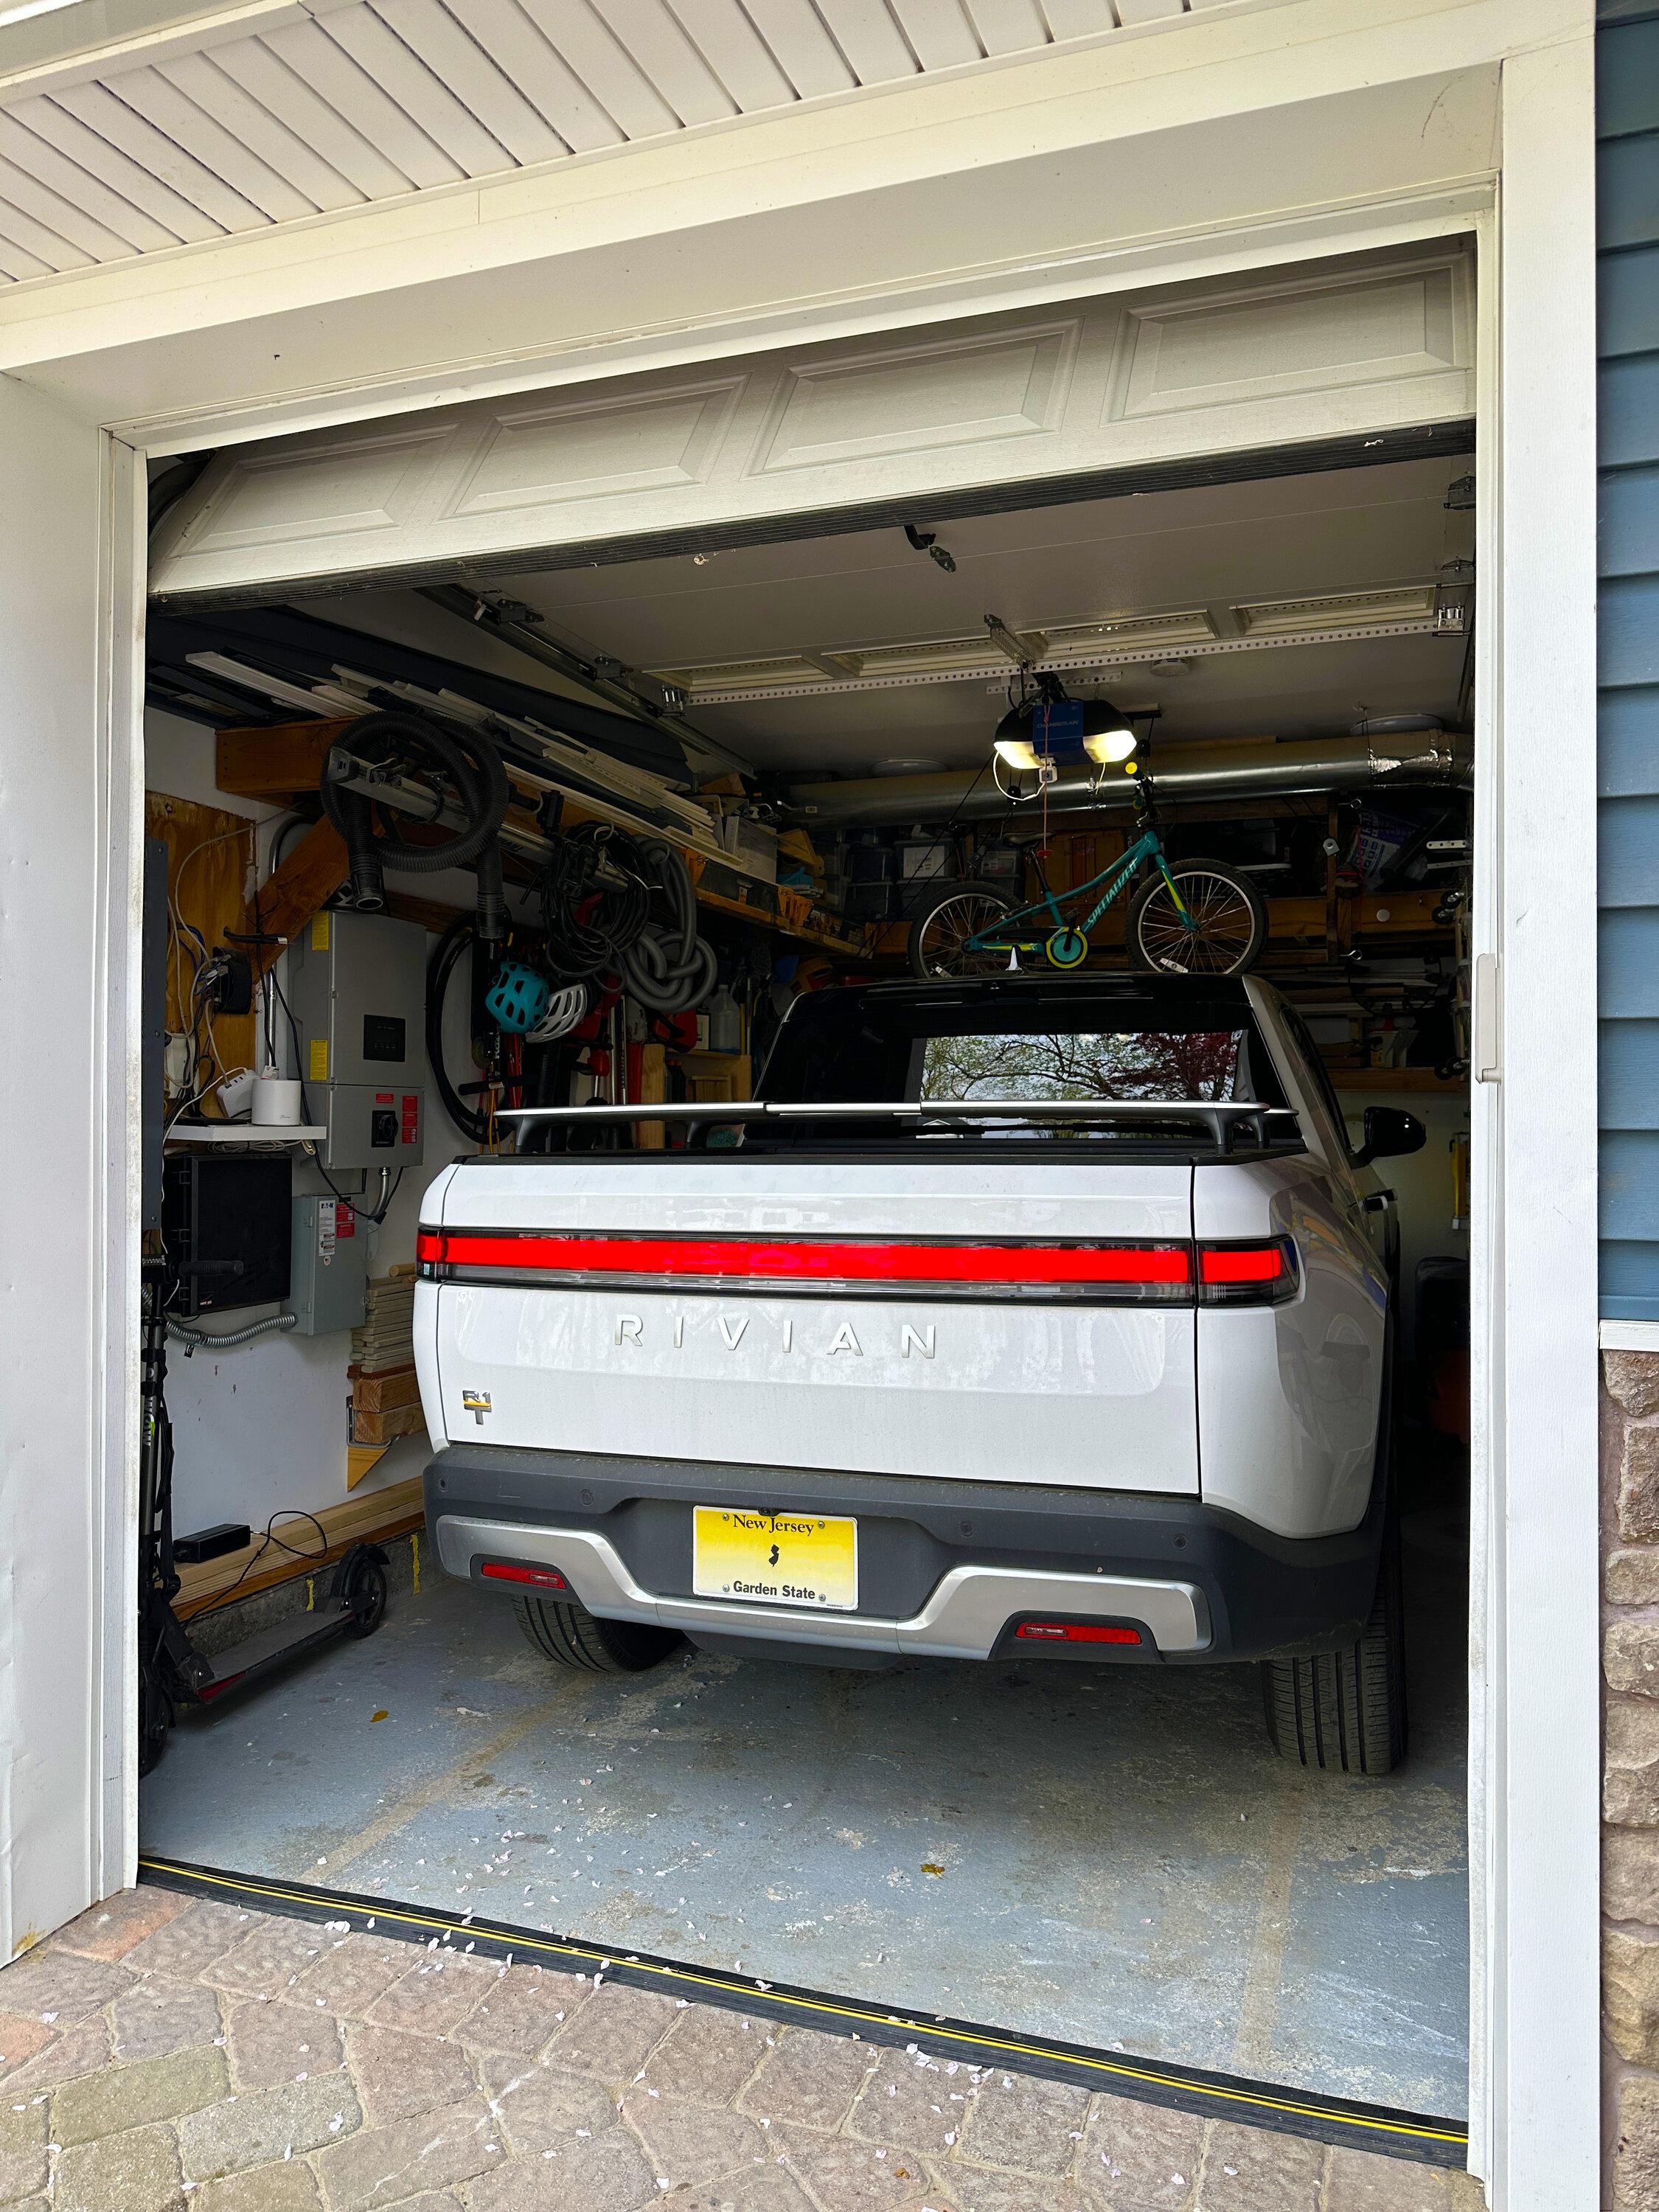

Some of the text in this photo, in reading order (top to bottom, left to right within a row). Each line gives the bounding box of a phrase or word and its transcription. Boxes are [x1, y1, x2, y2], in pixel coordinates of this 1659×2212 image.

[614, 1314, 936, 1359] RIVIAN
[732, 1514, 814, 1537] New Jersey
[733, 1580, 815, 1600] Garden State
